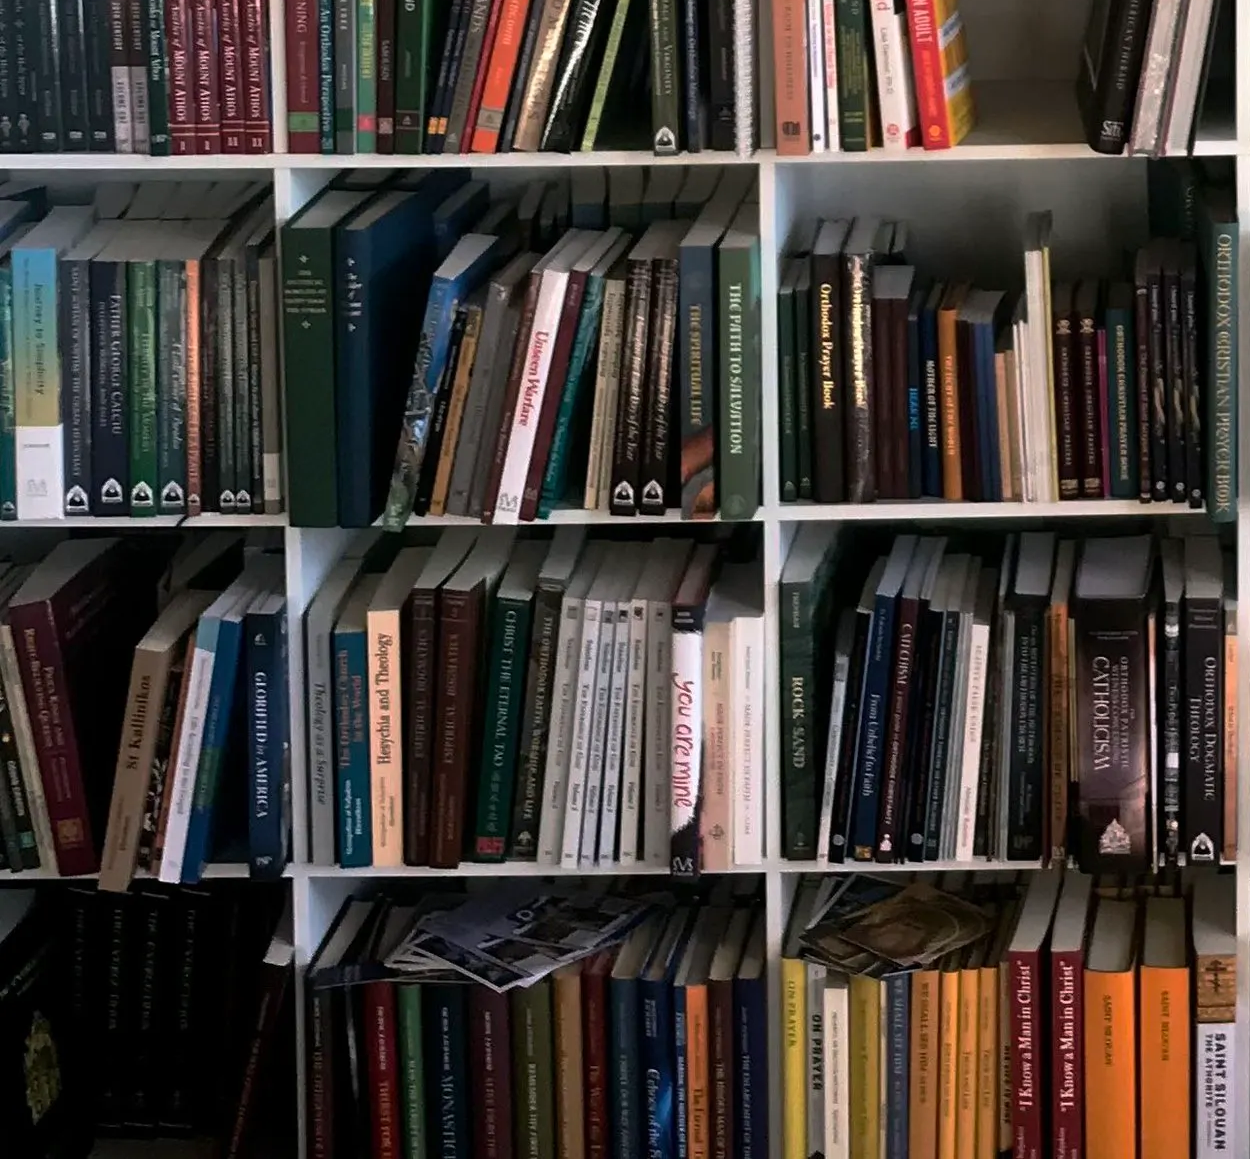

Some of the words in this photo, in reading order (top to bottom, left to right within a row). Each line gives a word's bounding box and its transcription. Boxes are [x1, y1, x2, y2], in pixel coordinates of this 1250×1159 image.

[913, 8, 932, 43] ADULT
[728, 283, 741, 310] THE
[821, 284, 832, 338] Orthodox
[528, 331, 549, 375] Unseen
[729, 356, 742, 374] TO
[820, 342, 832, 377] Prayer
[519, 379, 541, 426] Warfare
[822, 381, 834, 409] Book
[254, 672, 267, 741] GLORIFIED
[673, 673, 693, 716] you
[1092, 656, 1110, 771] CATHOLICISM
[1204, 657, 1217, 727] ORTHODOX
[256, 744, 265, 755] in
[674, 724, 694, 756] are
[1189, 695, 1202, 763] THEOLOGY
[255, 758, 267, 817] AMERICA
[673, 762, 693, 807] mine
[812, 1039, 823, 1090] PRAYER
[1214, 1033, 1225, 1077] SAINT
[1214, 1084, 1225, 1149] SILOUAN
